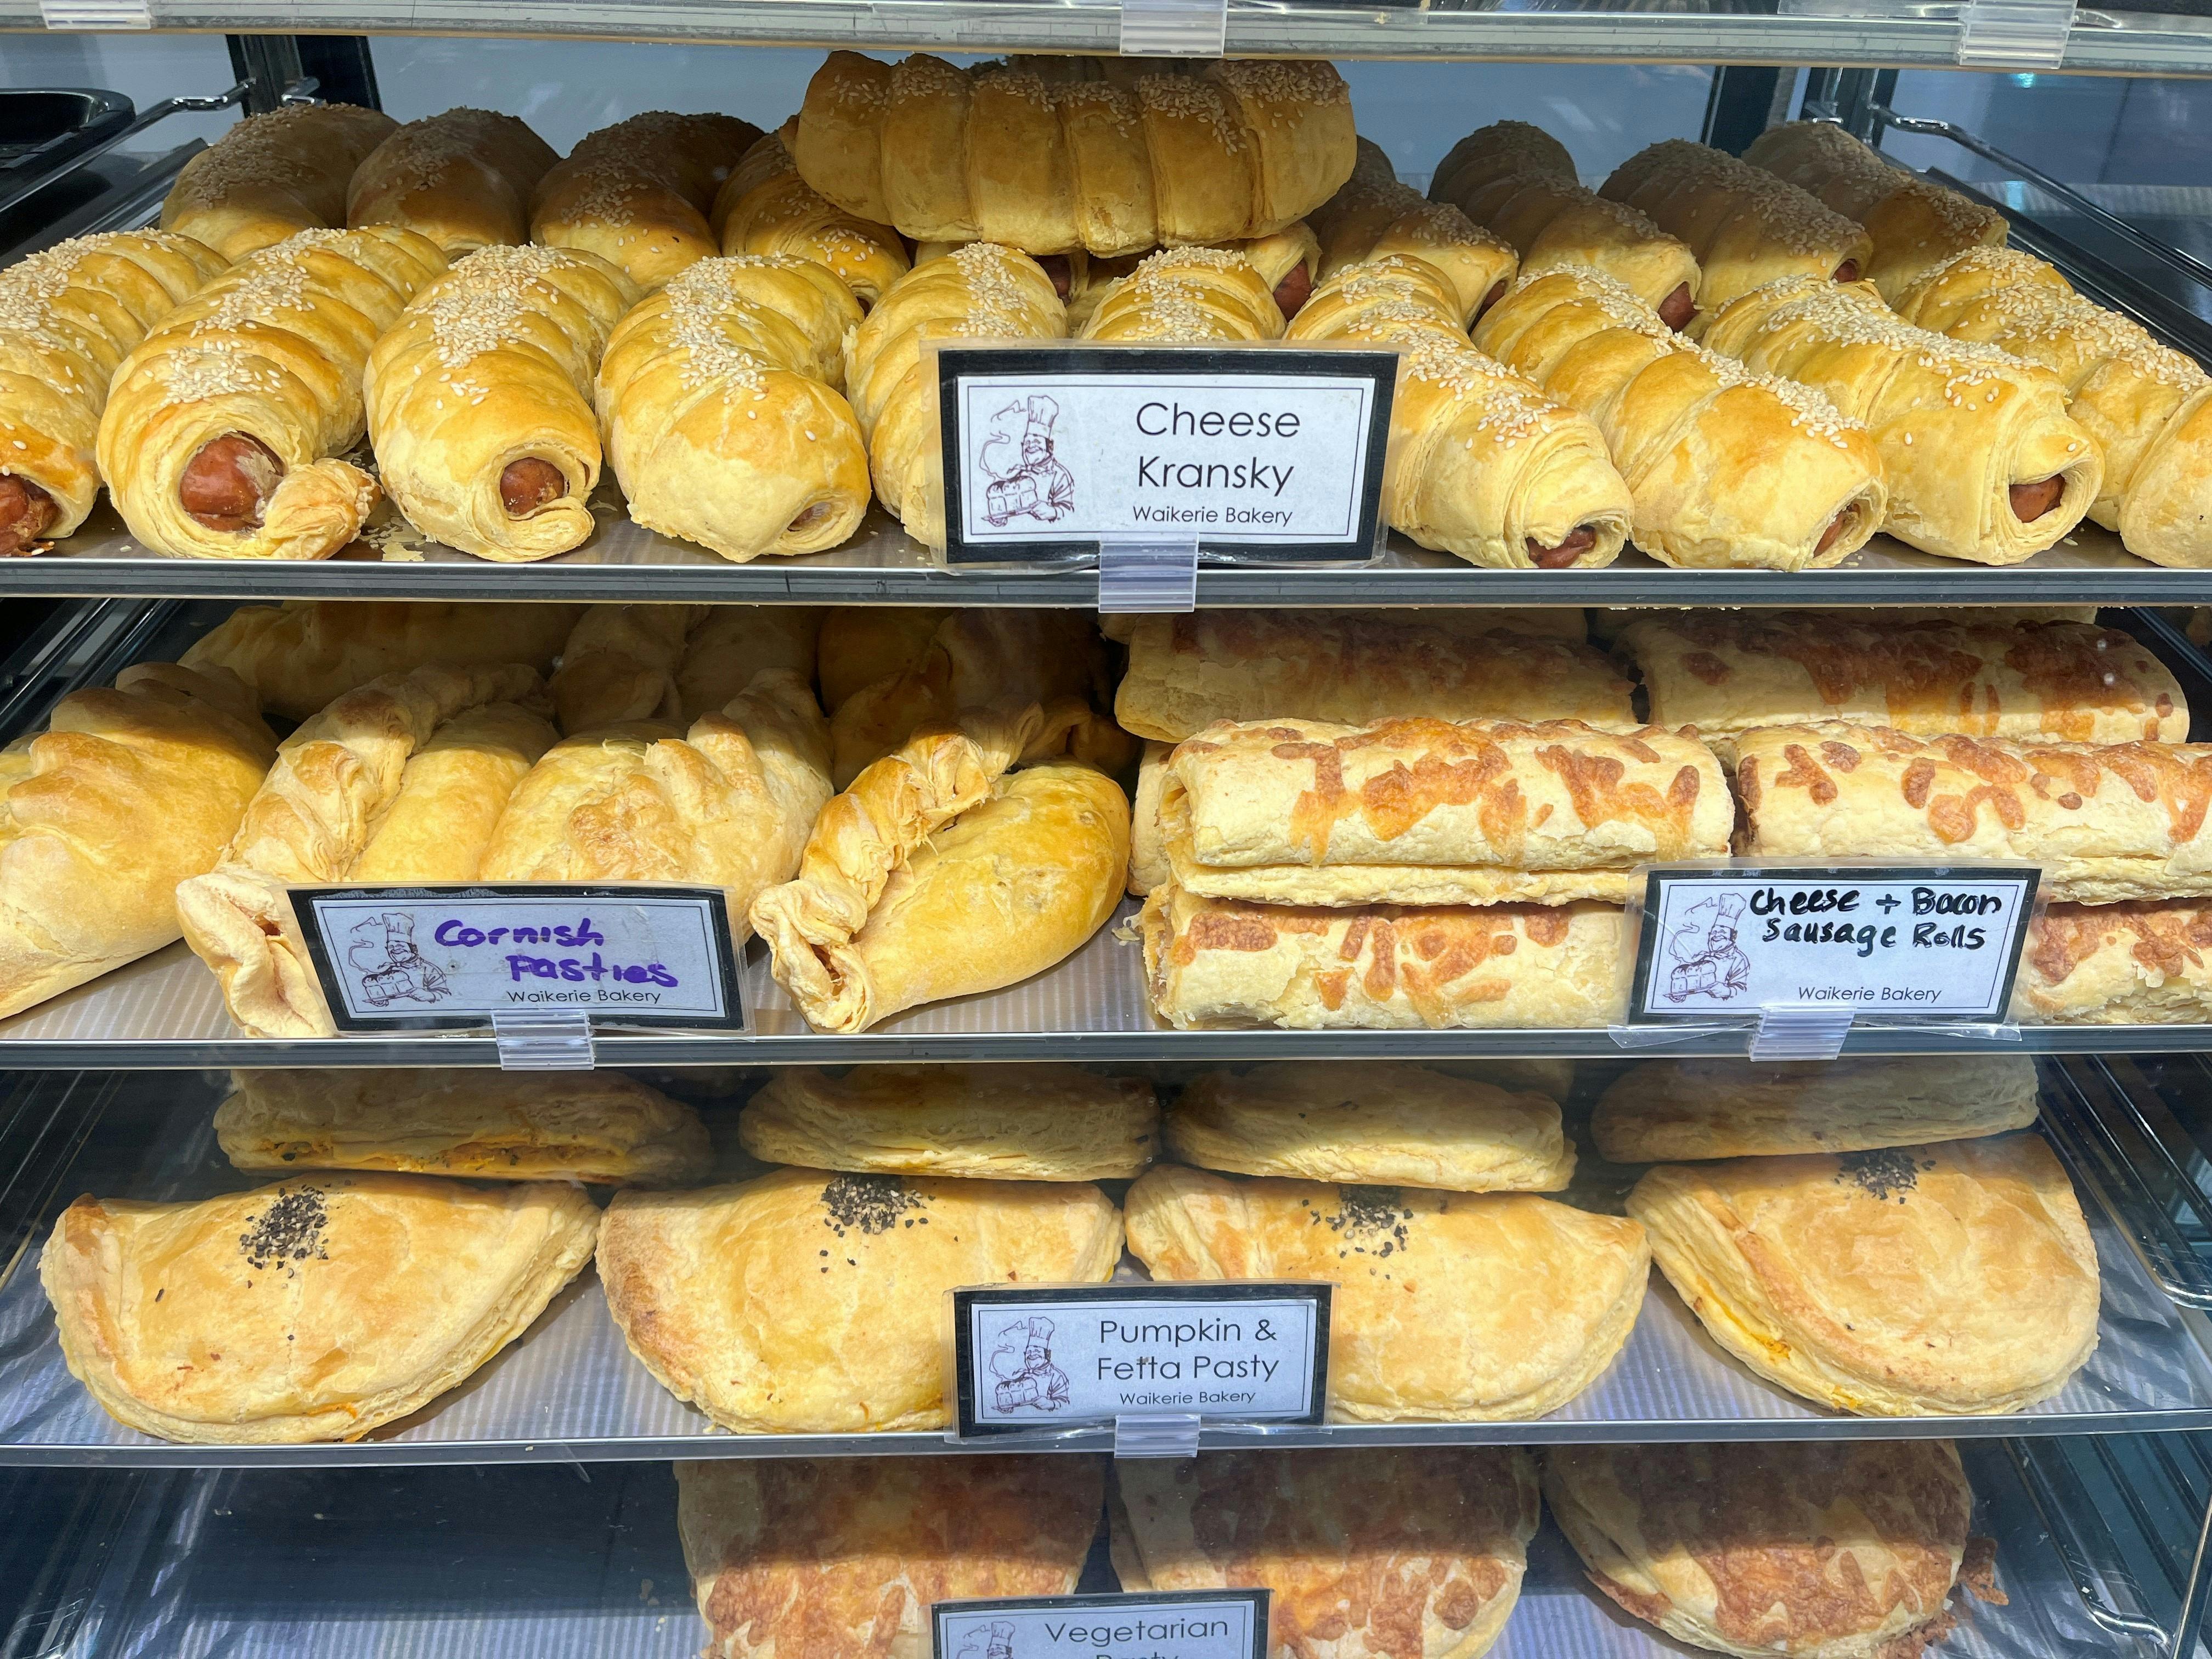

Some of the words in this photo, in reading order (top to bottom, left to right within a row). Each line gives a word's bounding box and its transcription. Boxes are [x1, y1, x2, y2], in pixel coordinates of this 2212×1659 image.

[1136, 402, 1300, 437] Cheese
[1138, 456, 1294, 496] Kransky
[1133, 506, 1218, 523] Waikerie
[1226, 507, 1293, 527] Bakery
[1875, 893, 1901, 915] +
[1911, 886, 2002, 916] Bacon
[434, 917, 605, 947] Cornish
[1762, 918, 1897, 958] Sausage
[1912, 922, 1987, 950] Rolls
[505, 952, 679, 988] Pasties
[507, 990, 591, 1002] Waikerie
[597, 990, 661, 1005] Bakery
[1799, 986, 1875, 1001] Waikerie
[1881, 987, 1942, 1003] Bakery
[1101, 1317, 1240, 1348] Pumpkin
[1255, 1319, 1278, 1341] &
[1098, 1356, 1180, 1380] Fetta
[1194, 1354, 1279, 1383] Pasty
[1120, 1392, 1193, 1405] Waikerie
[1199, 1390, 1256, 1404] Bakery
[1045, 1618, 1228, 1647] Vegetarian
